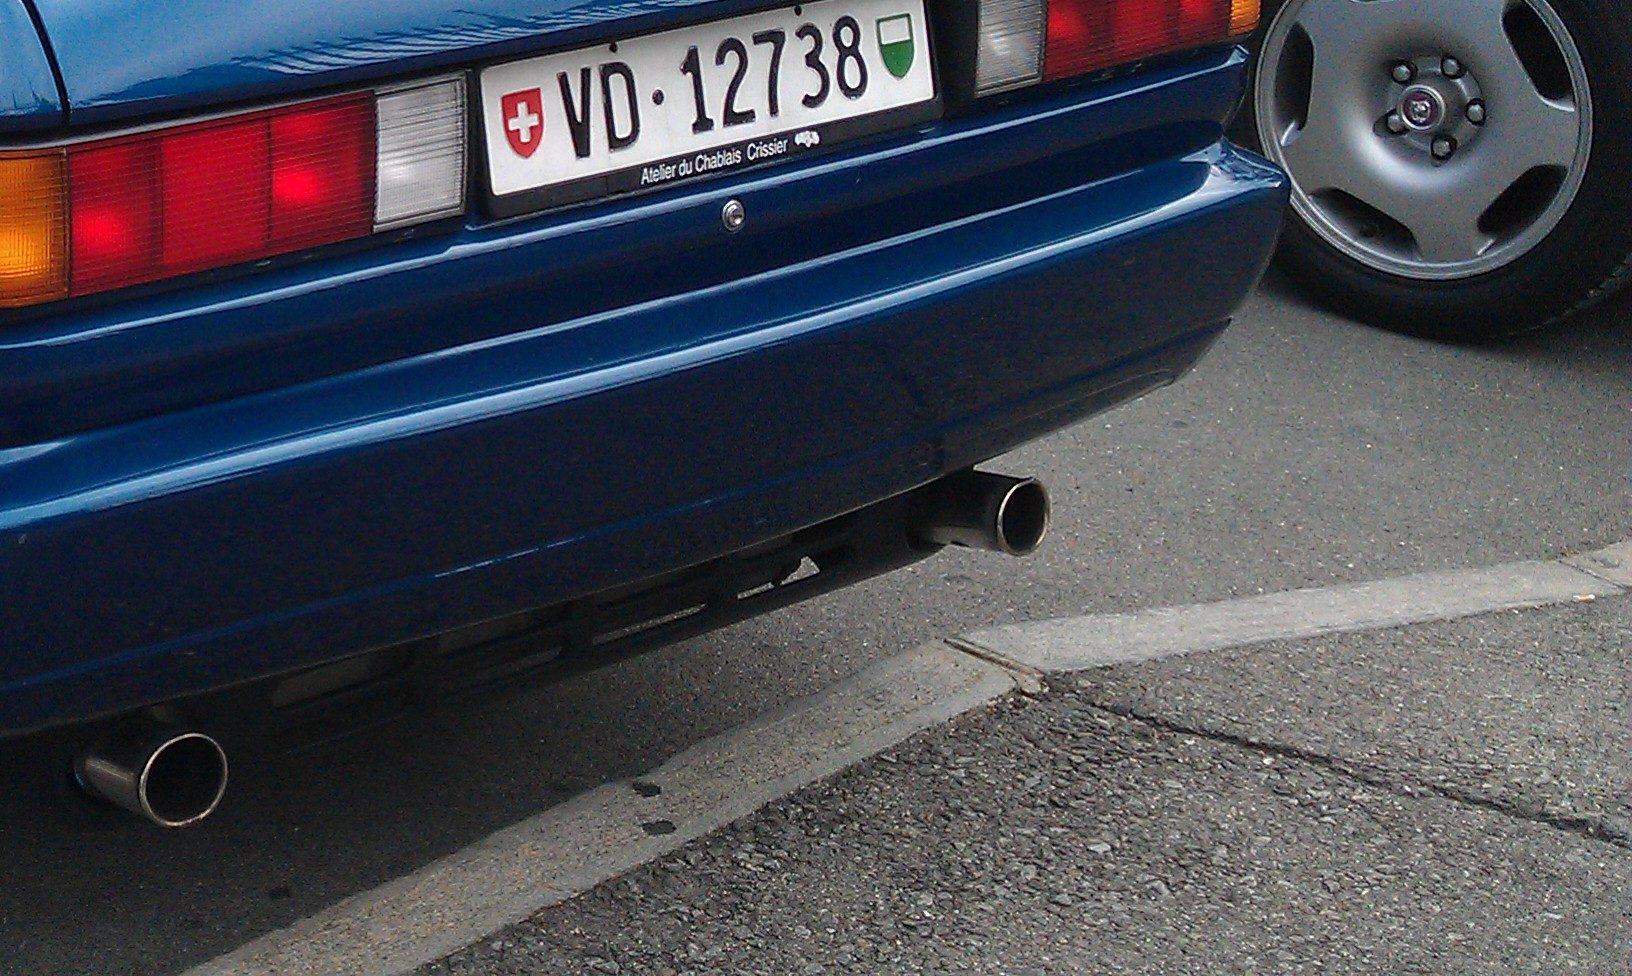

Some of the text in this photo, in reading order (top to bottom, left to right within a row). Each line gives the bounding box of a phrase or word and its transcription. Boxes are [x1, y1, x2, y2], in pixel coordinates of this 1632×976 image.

[640, 137, 789, 185] Atelier du Chablais Crissier
